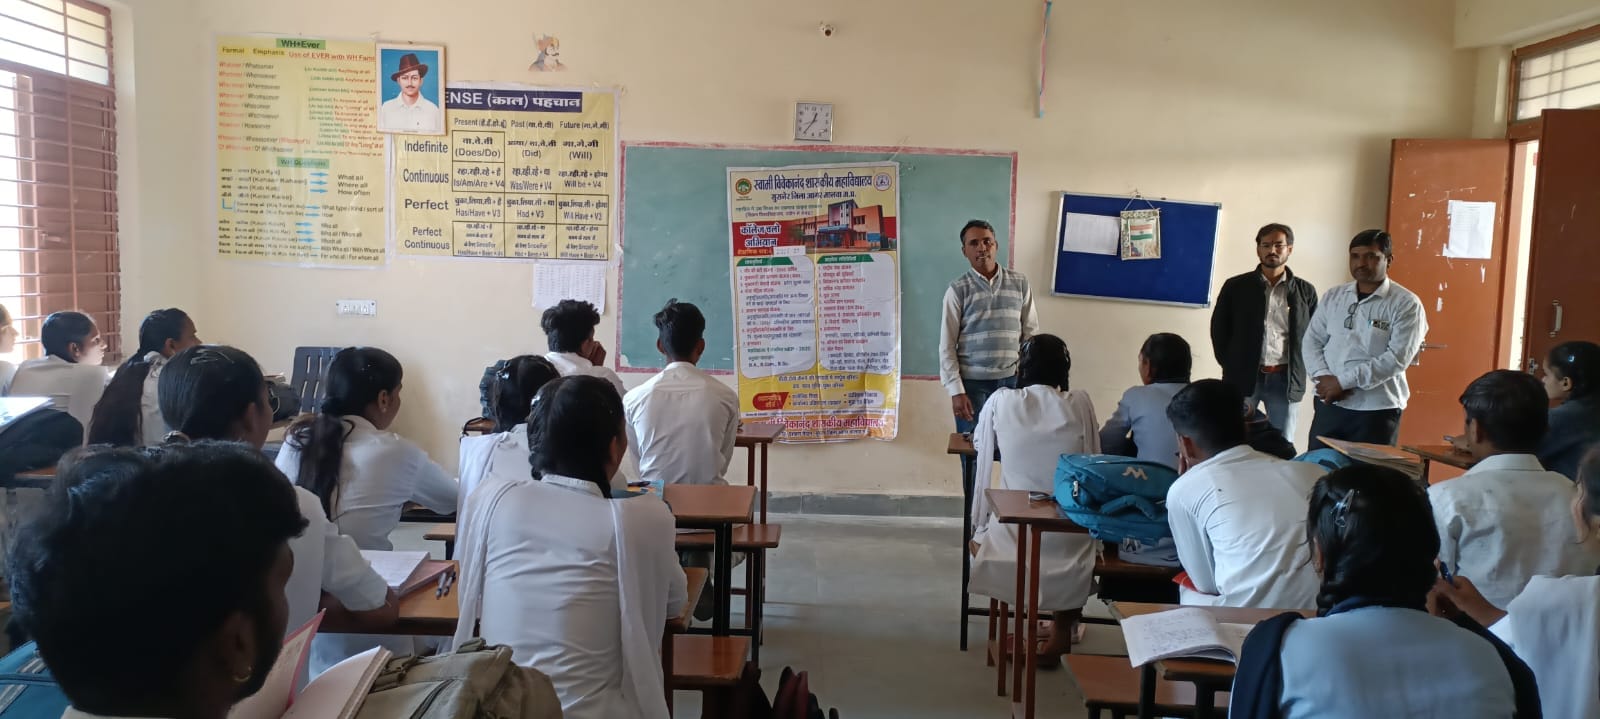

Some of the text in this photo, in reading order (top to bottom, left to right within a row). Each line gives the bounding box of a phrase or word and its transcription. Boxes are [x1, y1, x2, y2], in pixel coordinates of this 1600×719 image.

[281, 39, 320, 49] WH+Ever
[311, 52, 330, 60] EVER
[488, 94, 528, 108] (काल)
[532, 97, 581, 108] पहचान
[454, 117, 478, 127] Present
[510, 120, 526, 128] Past
[560, 120, 580, 128] Future
[404, 140, 448, 154] Indefinite
[455, 148, 500, 158] (Does/Do)
[522, 149, 542, 158] (Did)
[569, 151, 592, 160] (Will)
[403, 168, 449, 184] Continuous
[754, 171, 872, 191] स्वामी विवेकानंद शासकीय महाविद्यालय
[454, 180, 488, 188] Is/Am/Are
[510, 181, 539, 191] Was/Were
[564, 180, 577, 188] Will
[578, 180, 586, 188] be
[592, 180, 602, 188] V4
[404, 198, 449, 210] Perfect
[455, 208, 486, 218] Has/Have
[492, 209, 501, 218] V3
[516, 210, 530, 218] Had
[536, 210, 544, 218] V3
[564, 211, 574, 220] Will
[575, 212, 588, 220] Have
[412, 226, 442, 236] Perfect
[740, 222, 781, 235] कॉलेज चलो
[404, 240, 450, 250] Continuous
[745, 236, 778, 247] अभियान
[812, 416, 842, 428] शासकीय
